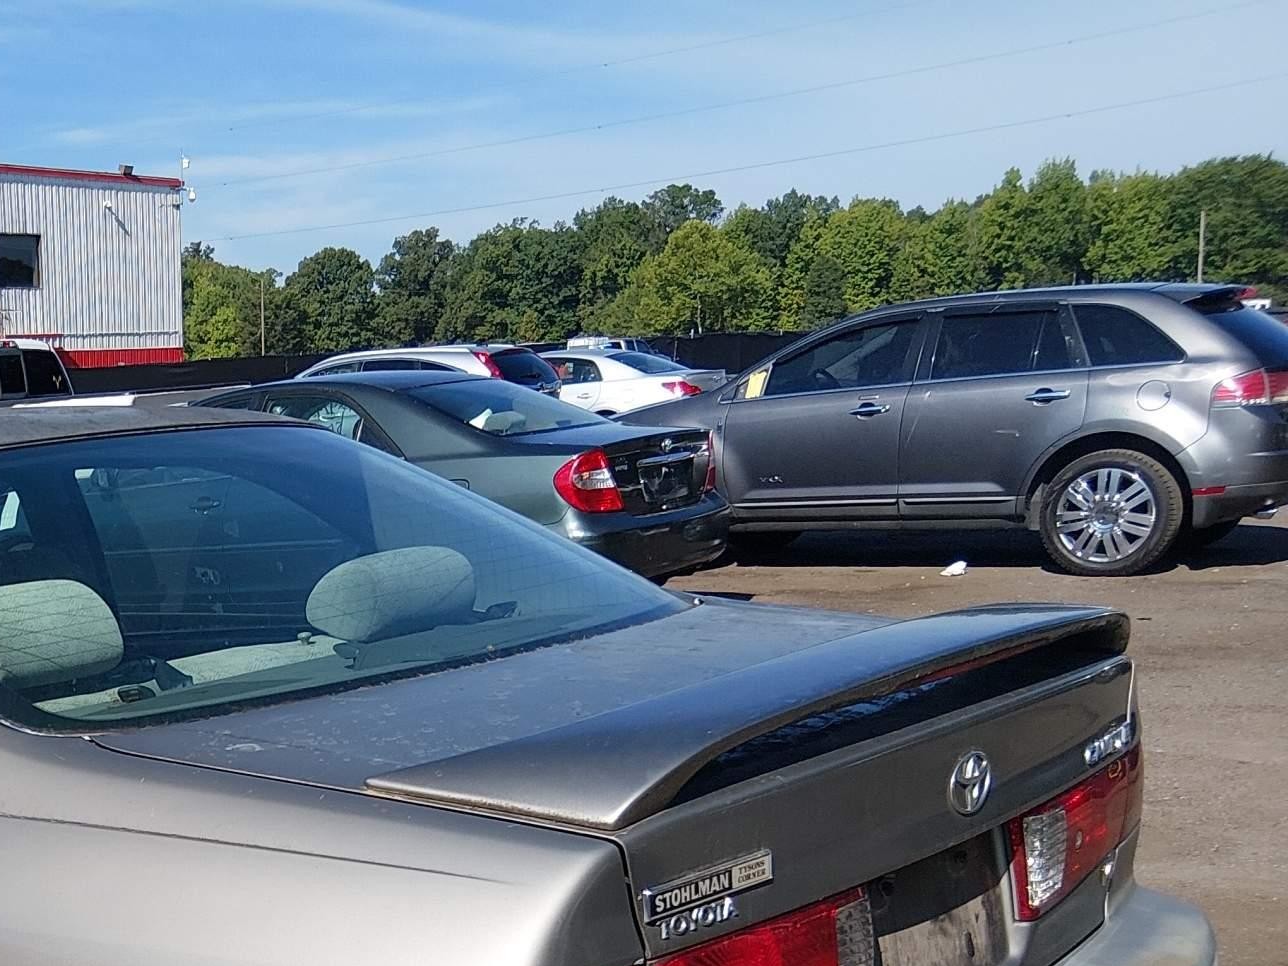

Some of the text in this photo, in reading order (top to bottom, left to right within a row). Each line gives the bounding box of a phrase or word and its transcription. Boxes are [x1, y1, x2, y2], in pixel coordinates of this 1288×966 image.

[655, 869, 730, 913] STOHLMAN
[737, 867, 766, 884] CORNER
[657, 896, 739, 940] TOYOTA
